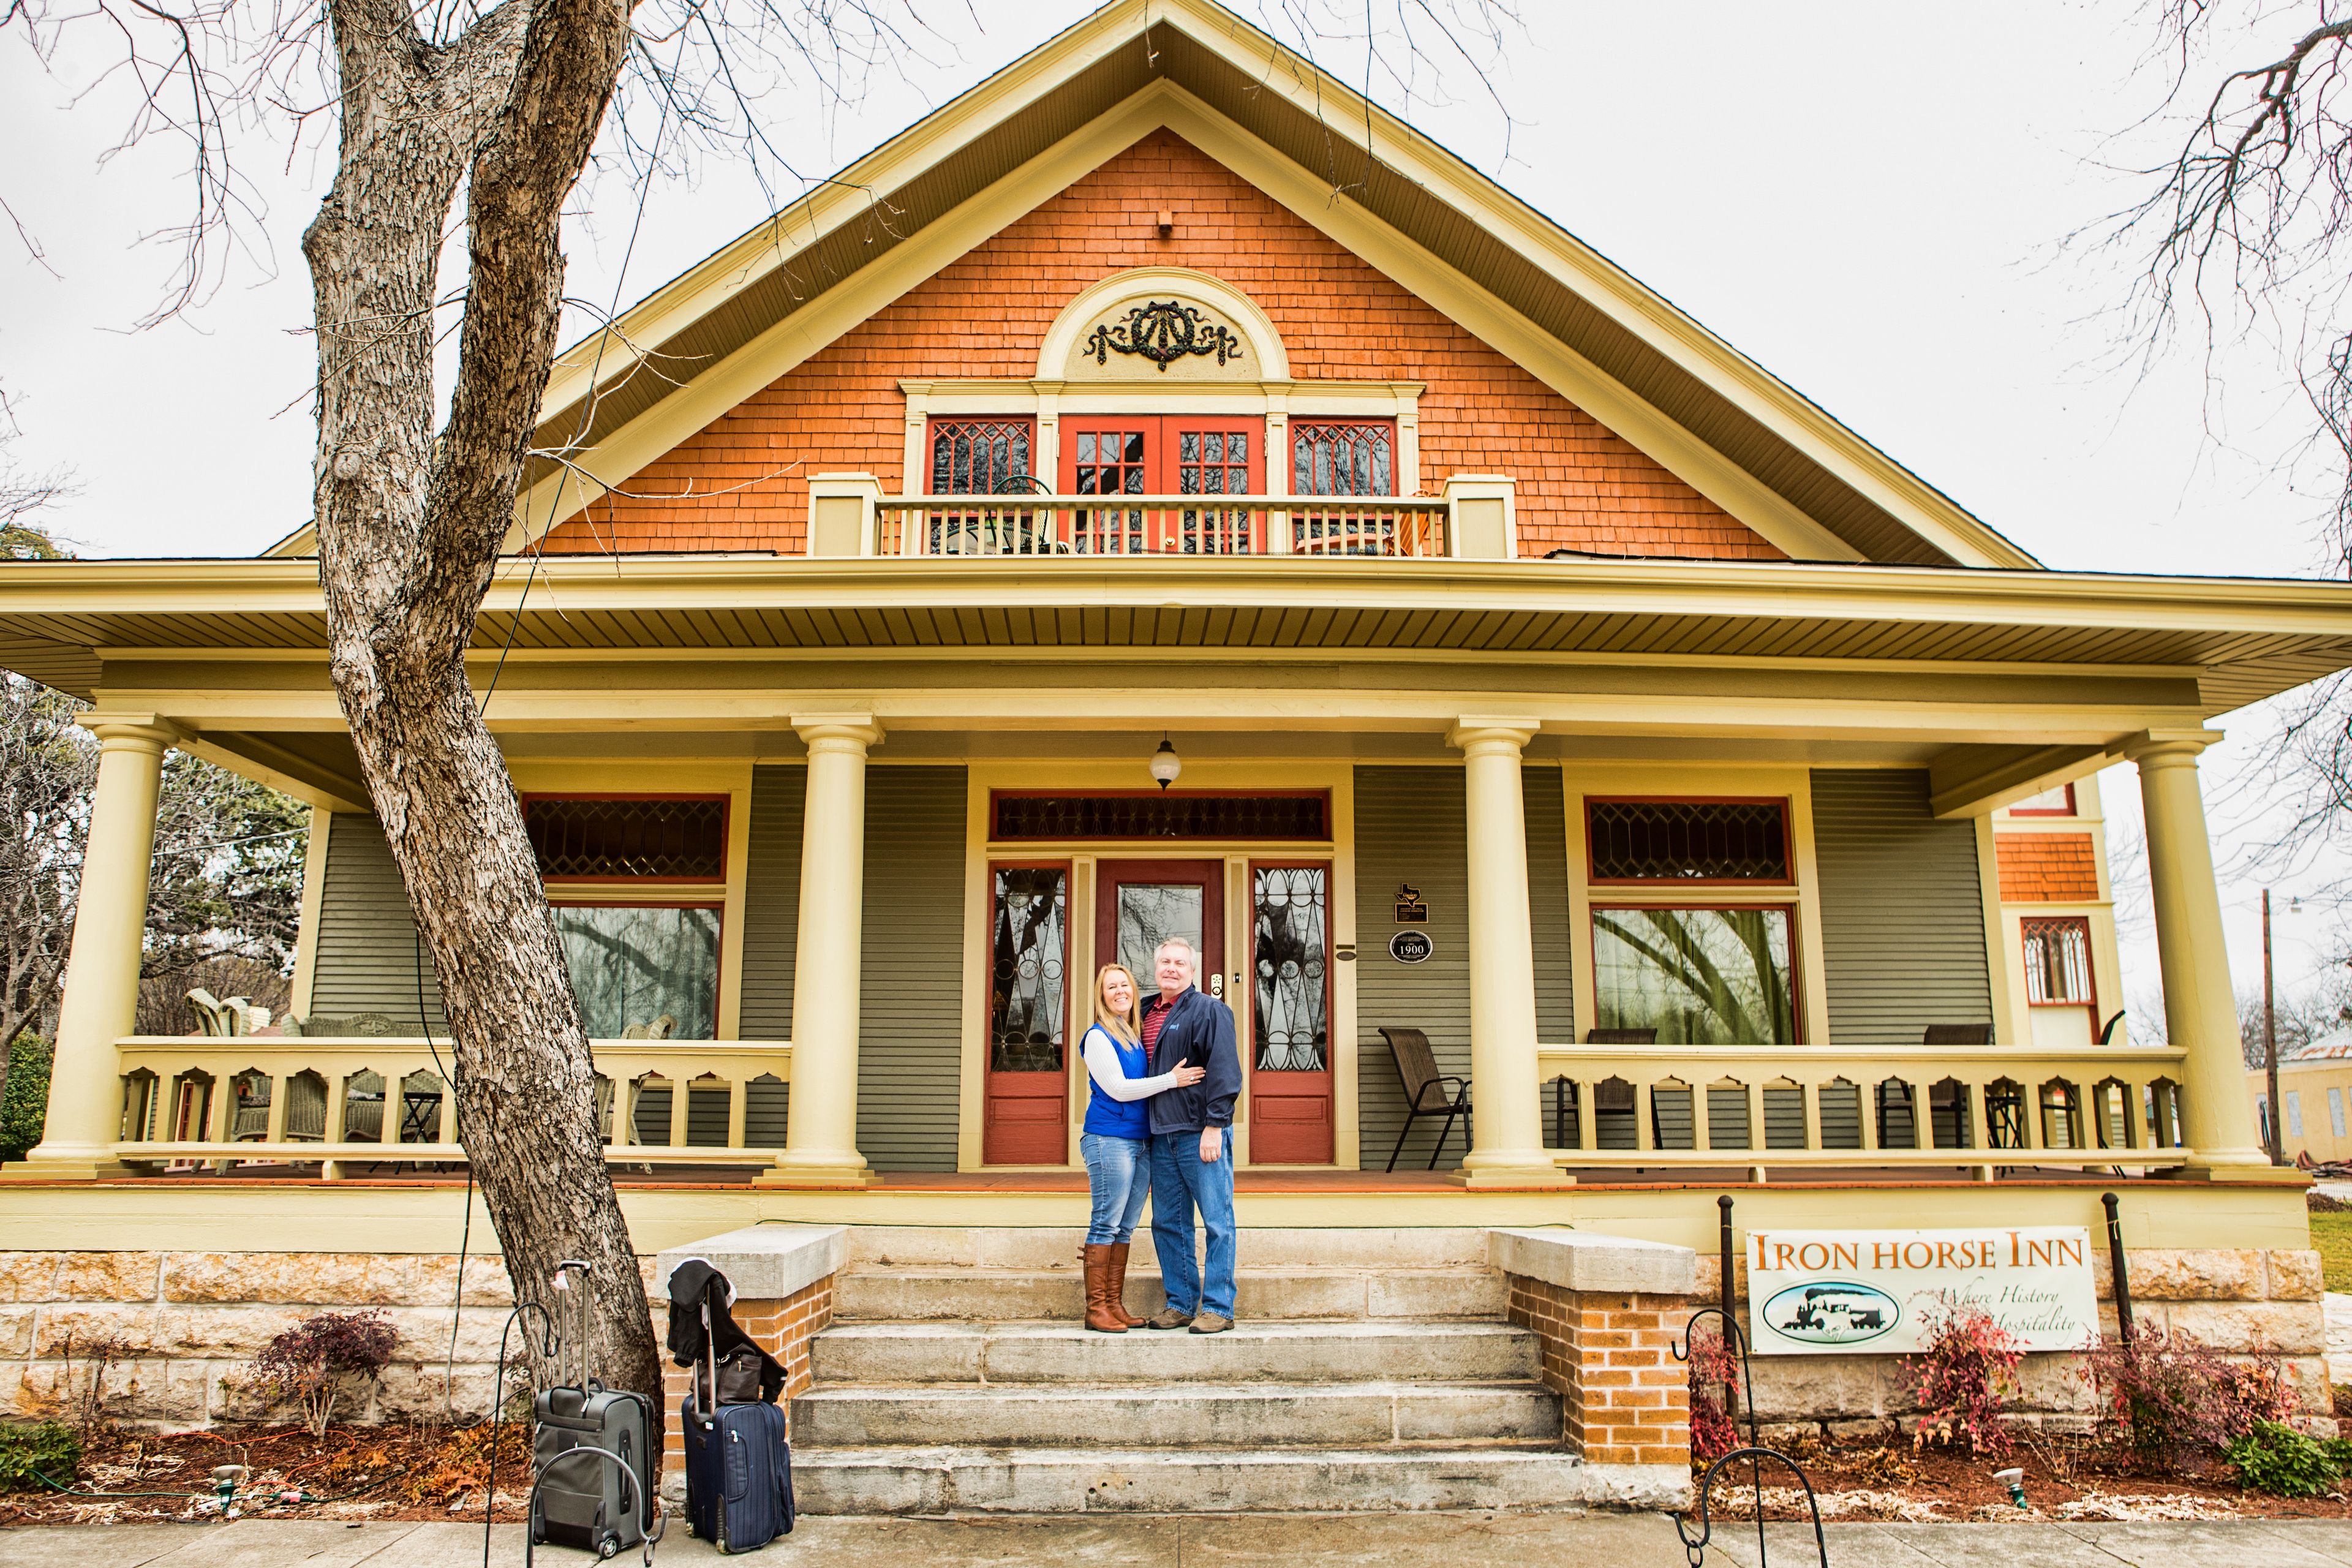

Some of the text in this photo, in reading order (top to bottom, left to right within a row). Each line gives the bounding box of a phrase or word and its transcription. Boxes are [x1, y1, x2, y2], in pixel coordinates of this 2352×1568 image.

[1400, 945, 1424, 954] 1900
[1754, 1231, 2083, 1271] IRON HORSE INN
[1940, 1275, 2059, 1317] Where History
